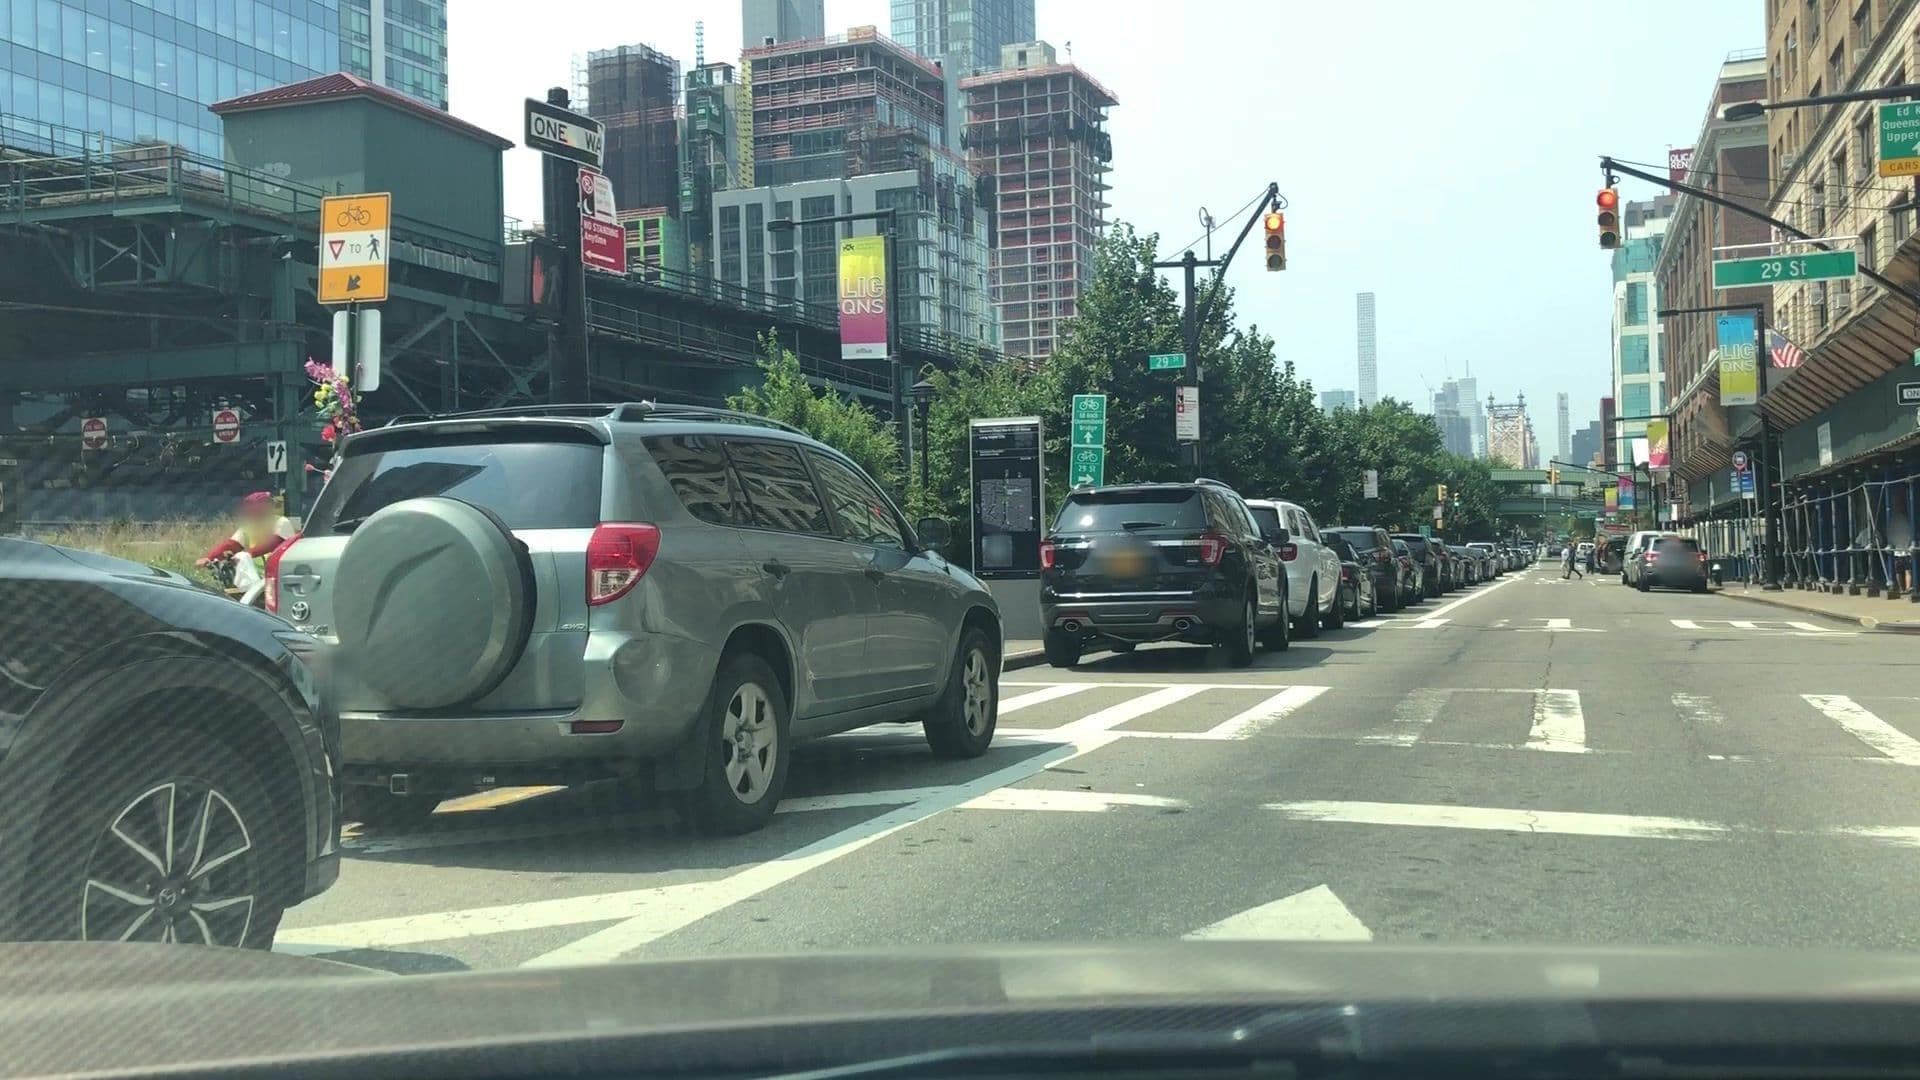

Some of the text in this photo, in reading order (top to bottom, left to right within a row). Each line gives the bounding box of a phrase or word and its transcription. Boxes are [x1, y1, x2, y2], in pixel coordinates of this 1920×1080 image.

[1896, 107, 1910, 117] Ed
[534, 117, 568, 143] ONE
[1882, 119, 1920, 131] Queens
[1886, 131, 1920, 143] Upper
[1889, 161, 1919, 172] CARS
[584, 220, 619, 238] NO STANDING
[584, 231, 607, 246] Anytime
[350, 243, 361, 254] TO
[1761, 260, 1807, 279] 29 St
[841, 276, 885, 298] LIC
[841, 299, 885, 315] QNS
[1719, 342, 1755, 361] LIC
[1156, 356, 1169, 368] 29
[1720, 360, 1755, 373] QNS
